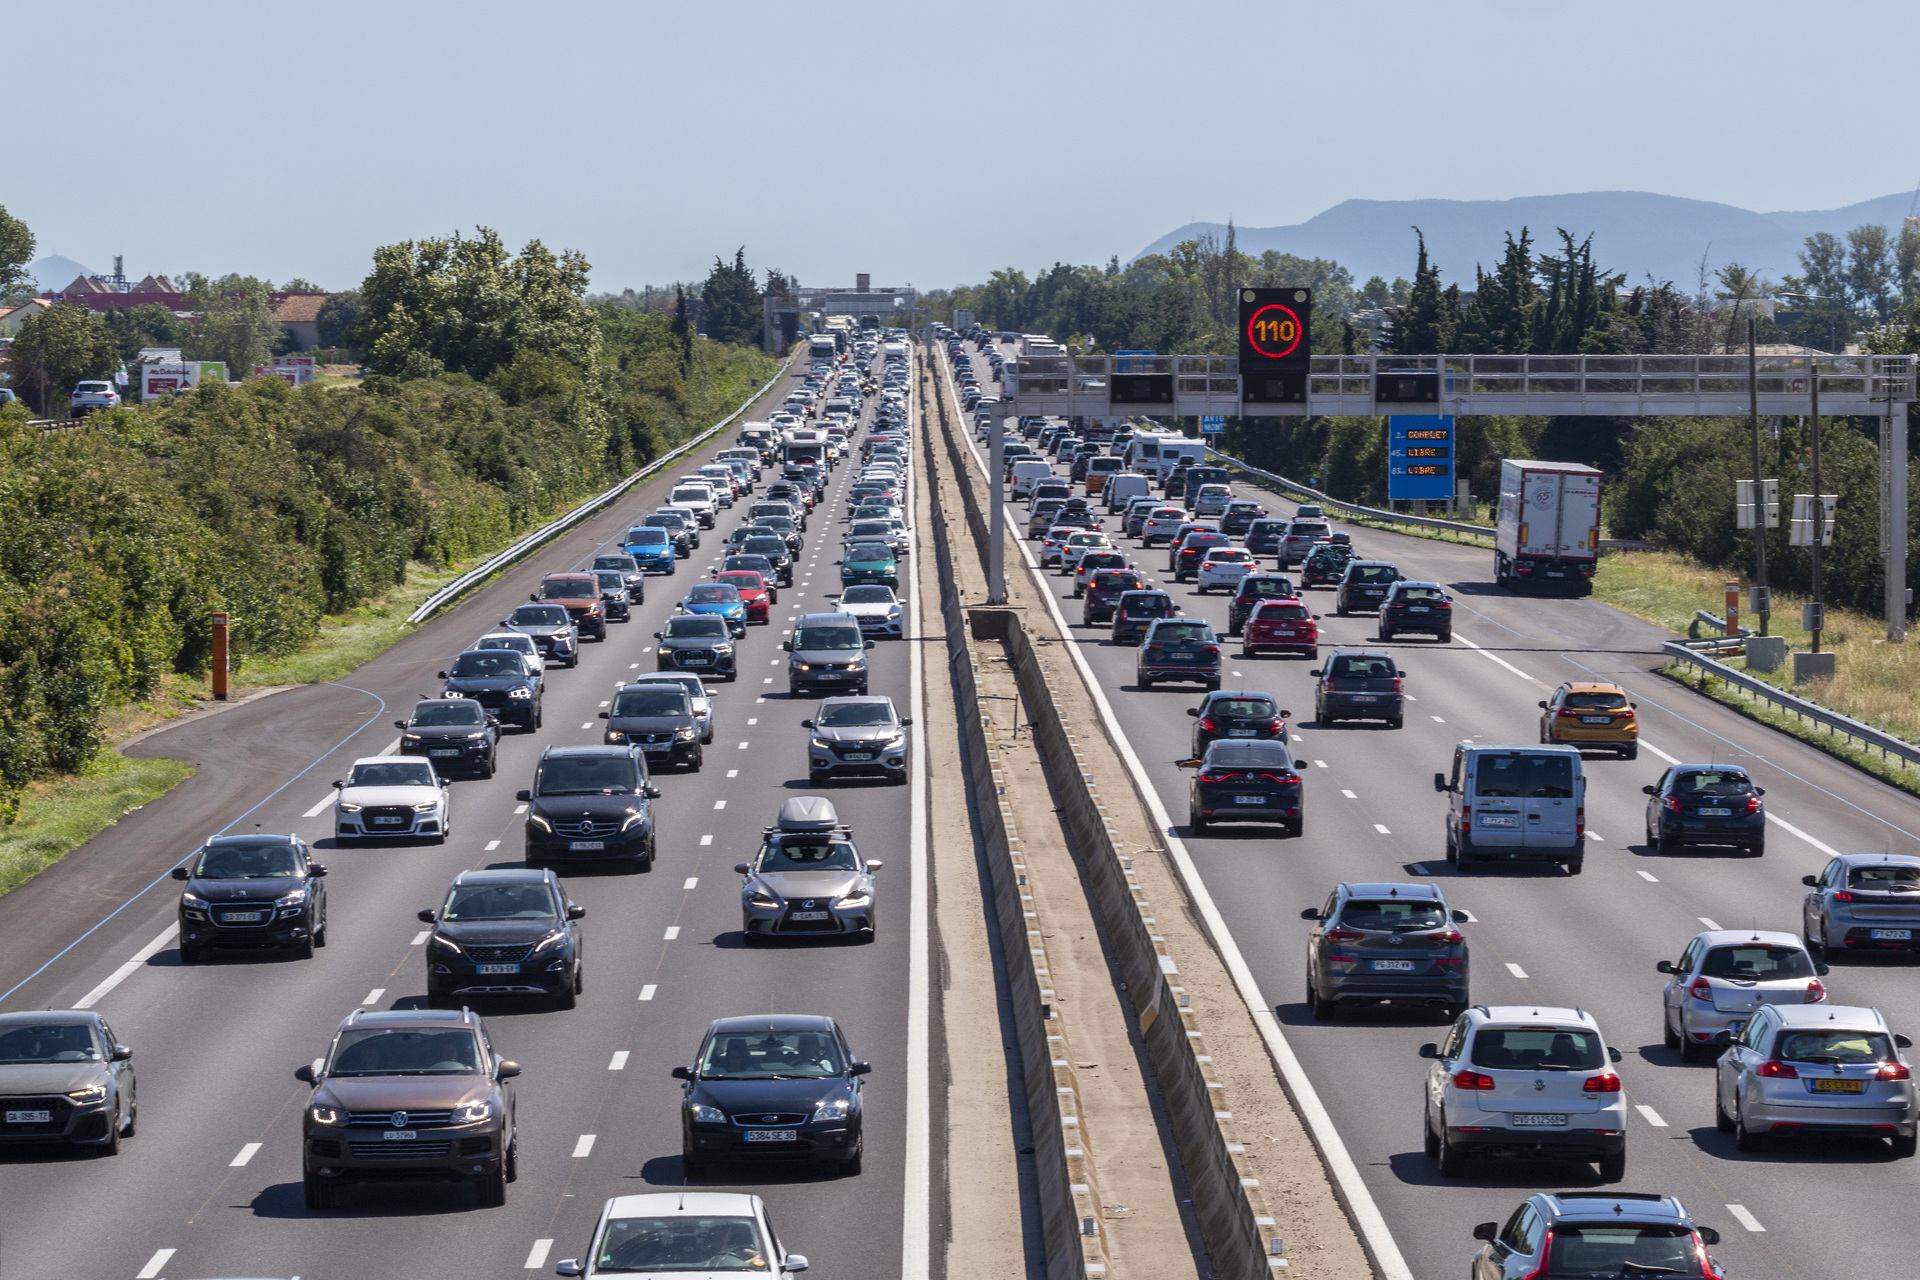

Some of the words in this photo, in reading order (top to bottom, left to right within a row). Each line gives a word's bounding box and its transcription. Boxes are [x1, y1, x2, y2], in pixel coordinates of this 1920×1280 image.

[95, 274, 126, 284] HOTEL
[1255, 320, 1295, 341] 110
[1407, 430, 1447, 439] COMPLET
[1408, 448, 1436, 457] LIBRE
[1407, 466, 1436, 475] LIBRE
[749, 1130, 770, 1141] 5384
[771, 1130, 782, 1140] SE
[783, 1130, 795, 1140] 36
